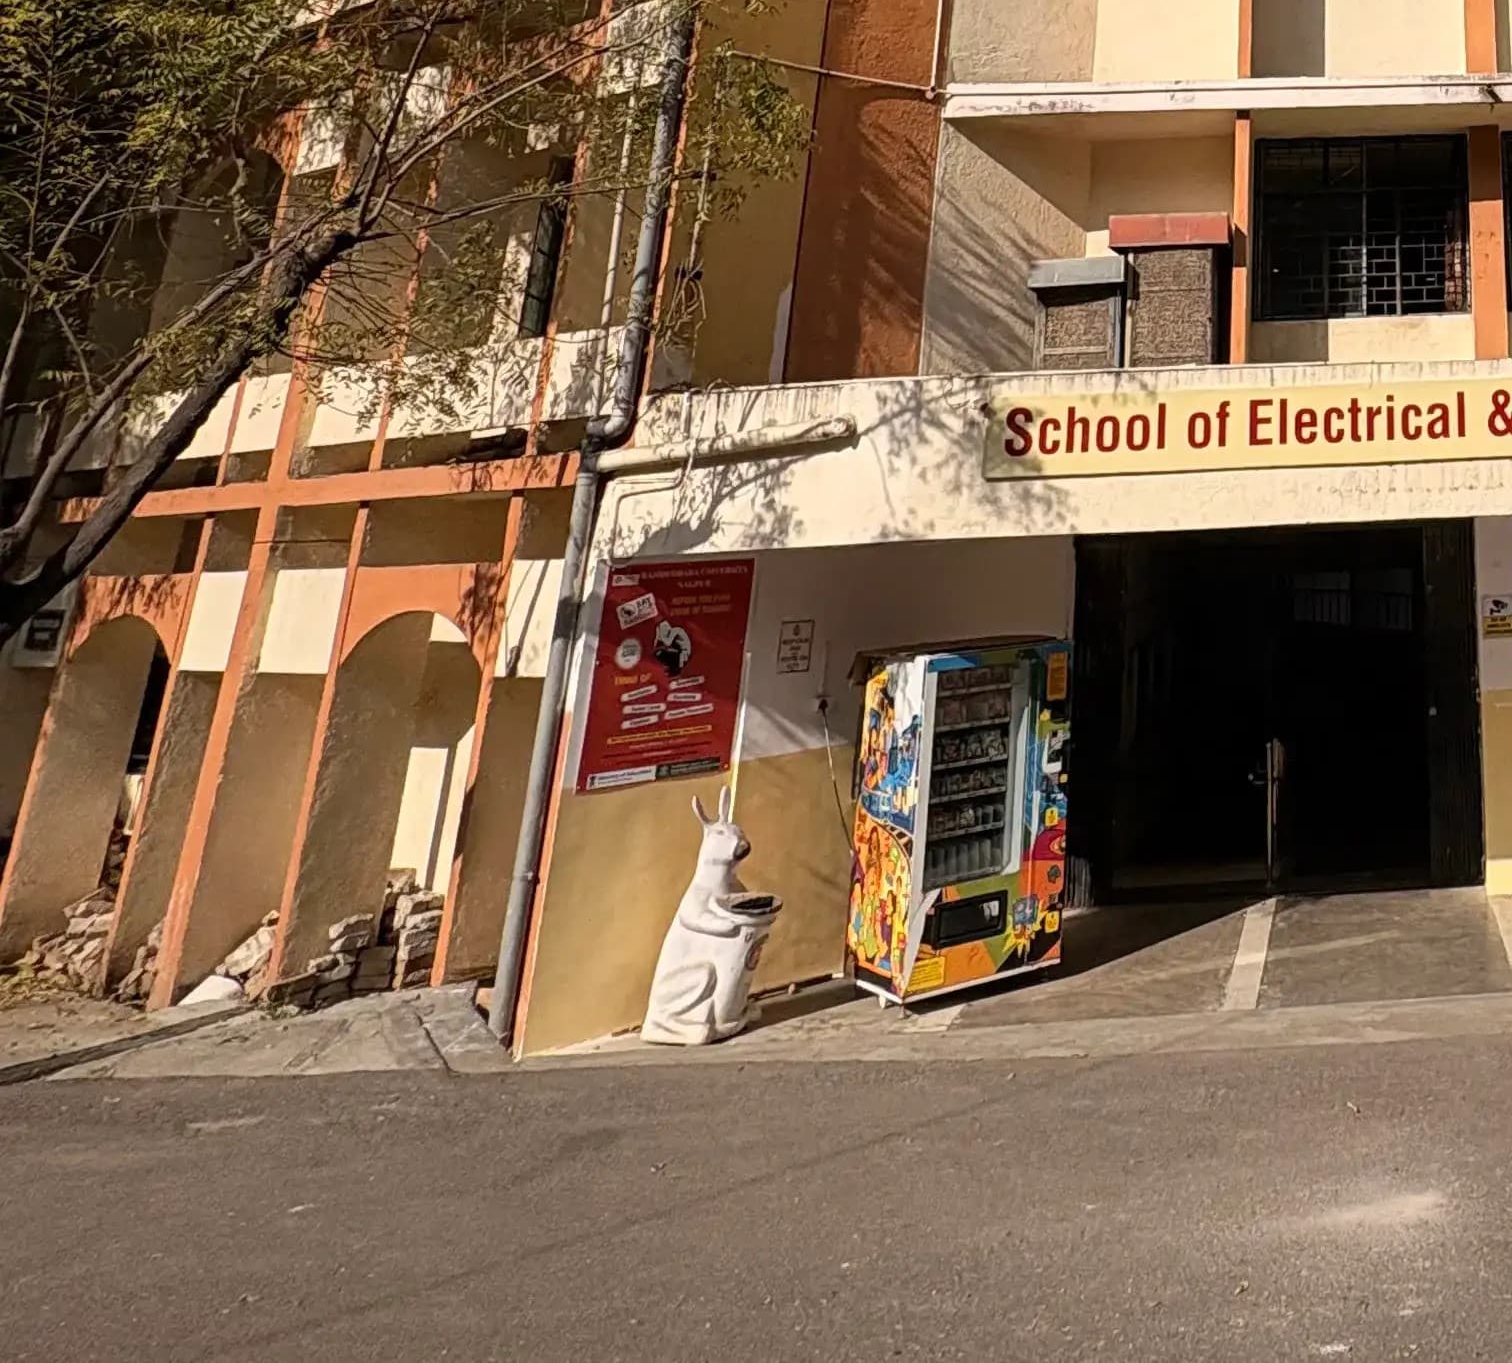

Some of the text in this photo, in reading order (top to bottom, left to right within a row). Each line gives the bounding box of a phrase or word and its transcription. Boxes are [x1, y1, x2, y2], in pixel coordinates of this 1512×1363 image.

[1003, 403, 1167, 457] School
[1187, 400, 1231, 449] of
[1248, 391, 1467, 446] Electrical
